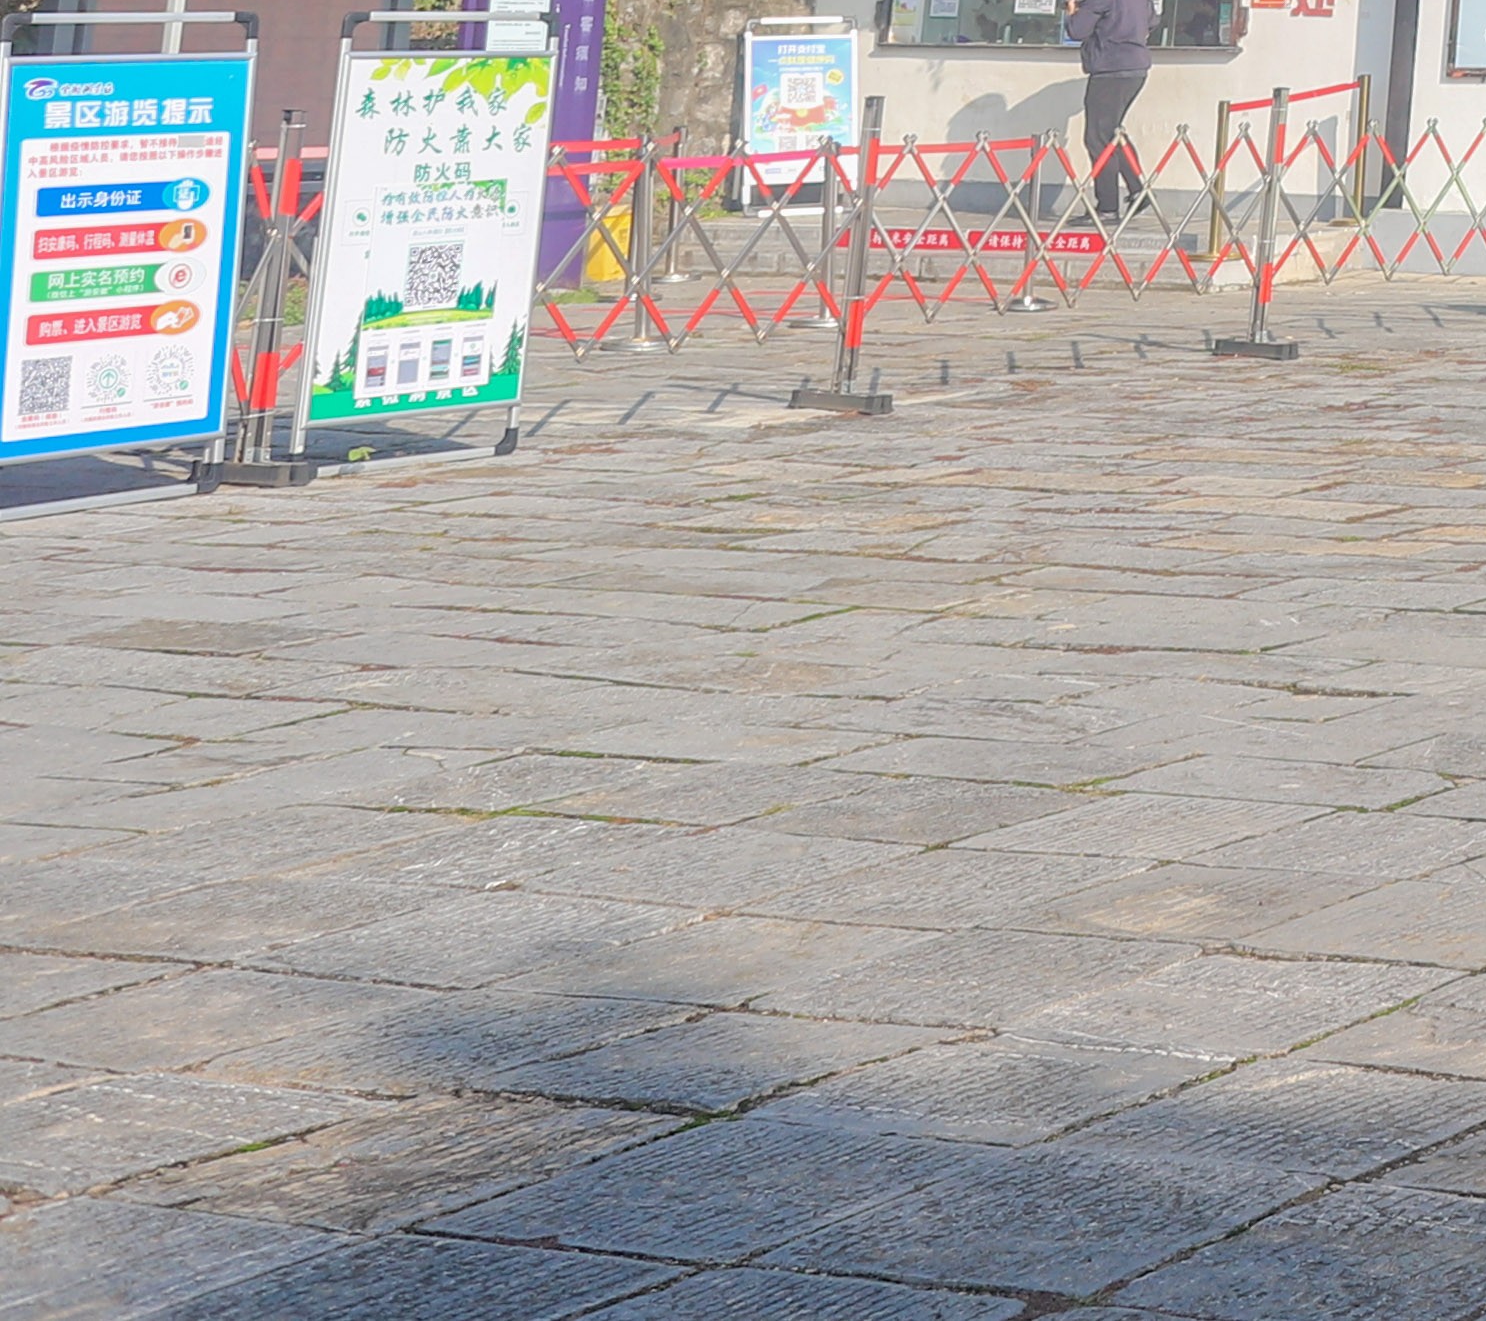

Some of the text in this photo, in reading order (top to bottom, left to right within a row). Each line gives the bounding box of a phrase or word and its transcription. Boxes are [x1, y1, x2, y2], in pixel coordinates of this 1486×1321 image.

[44, 97, 213, 129] 景区游览提示
[413, 161, 472, 183] 防火码
[60, 190, 142, 209] 出示身份证
[48, 268, 145, 289] 网上实名预约
